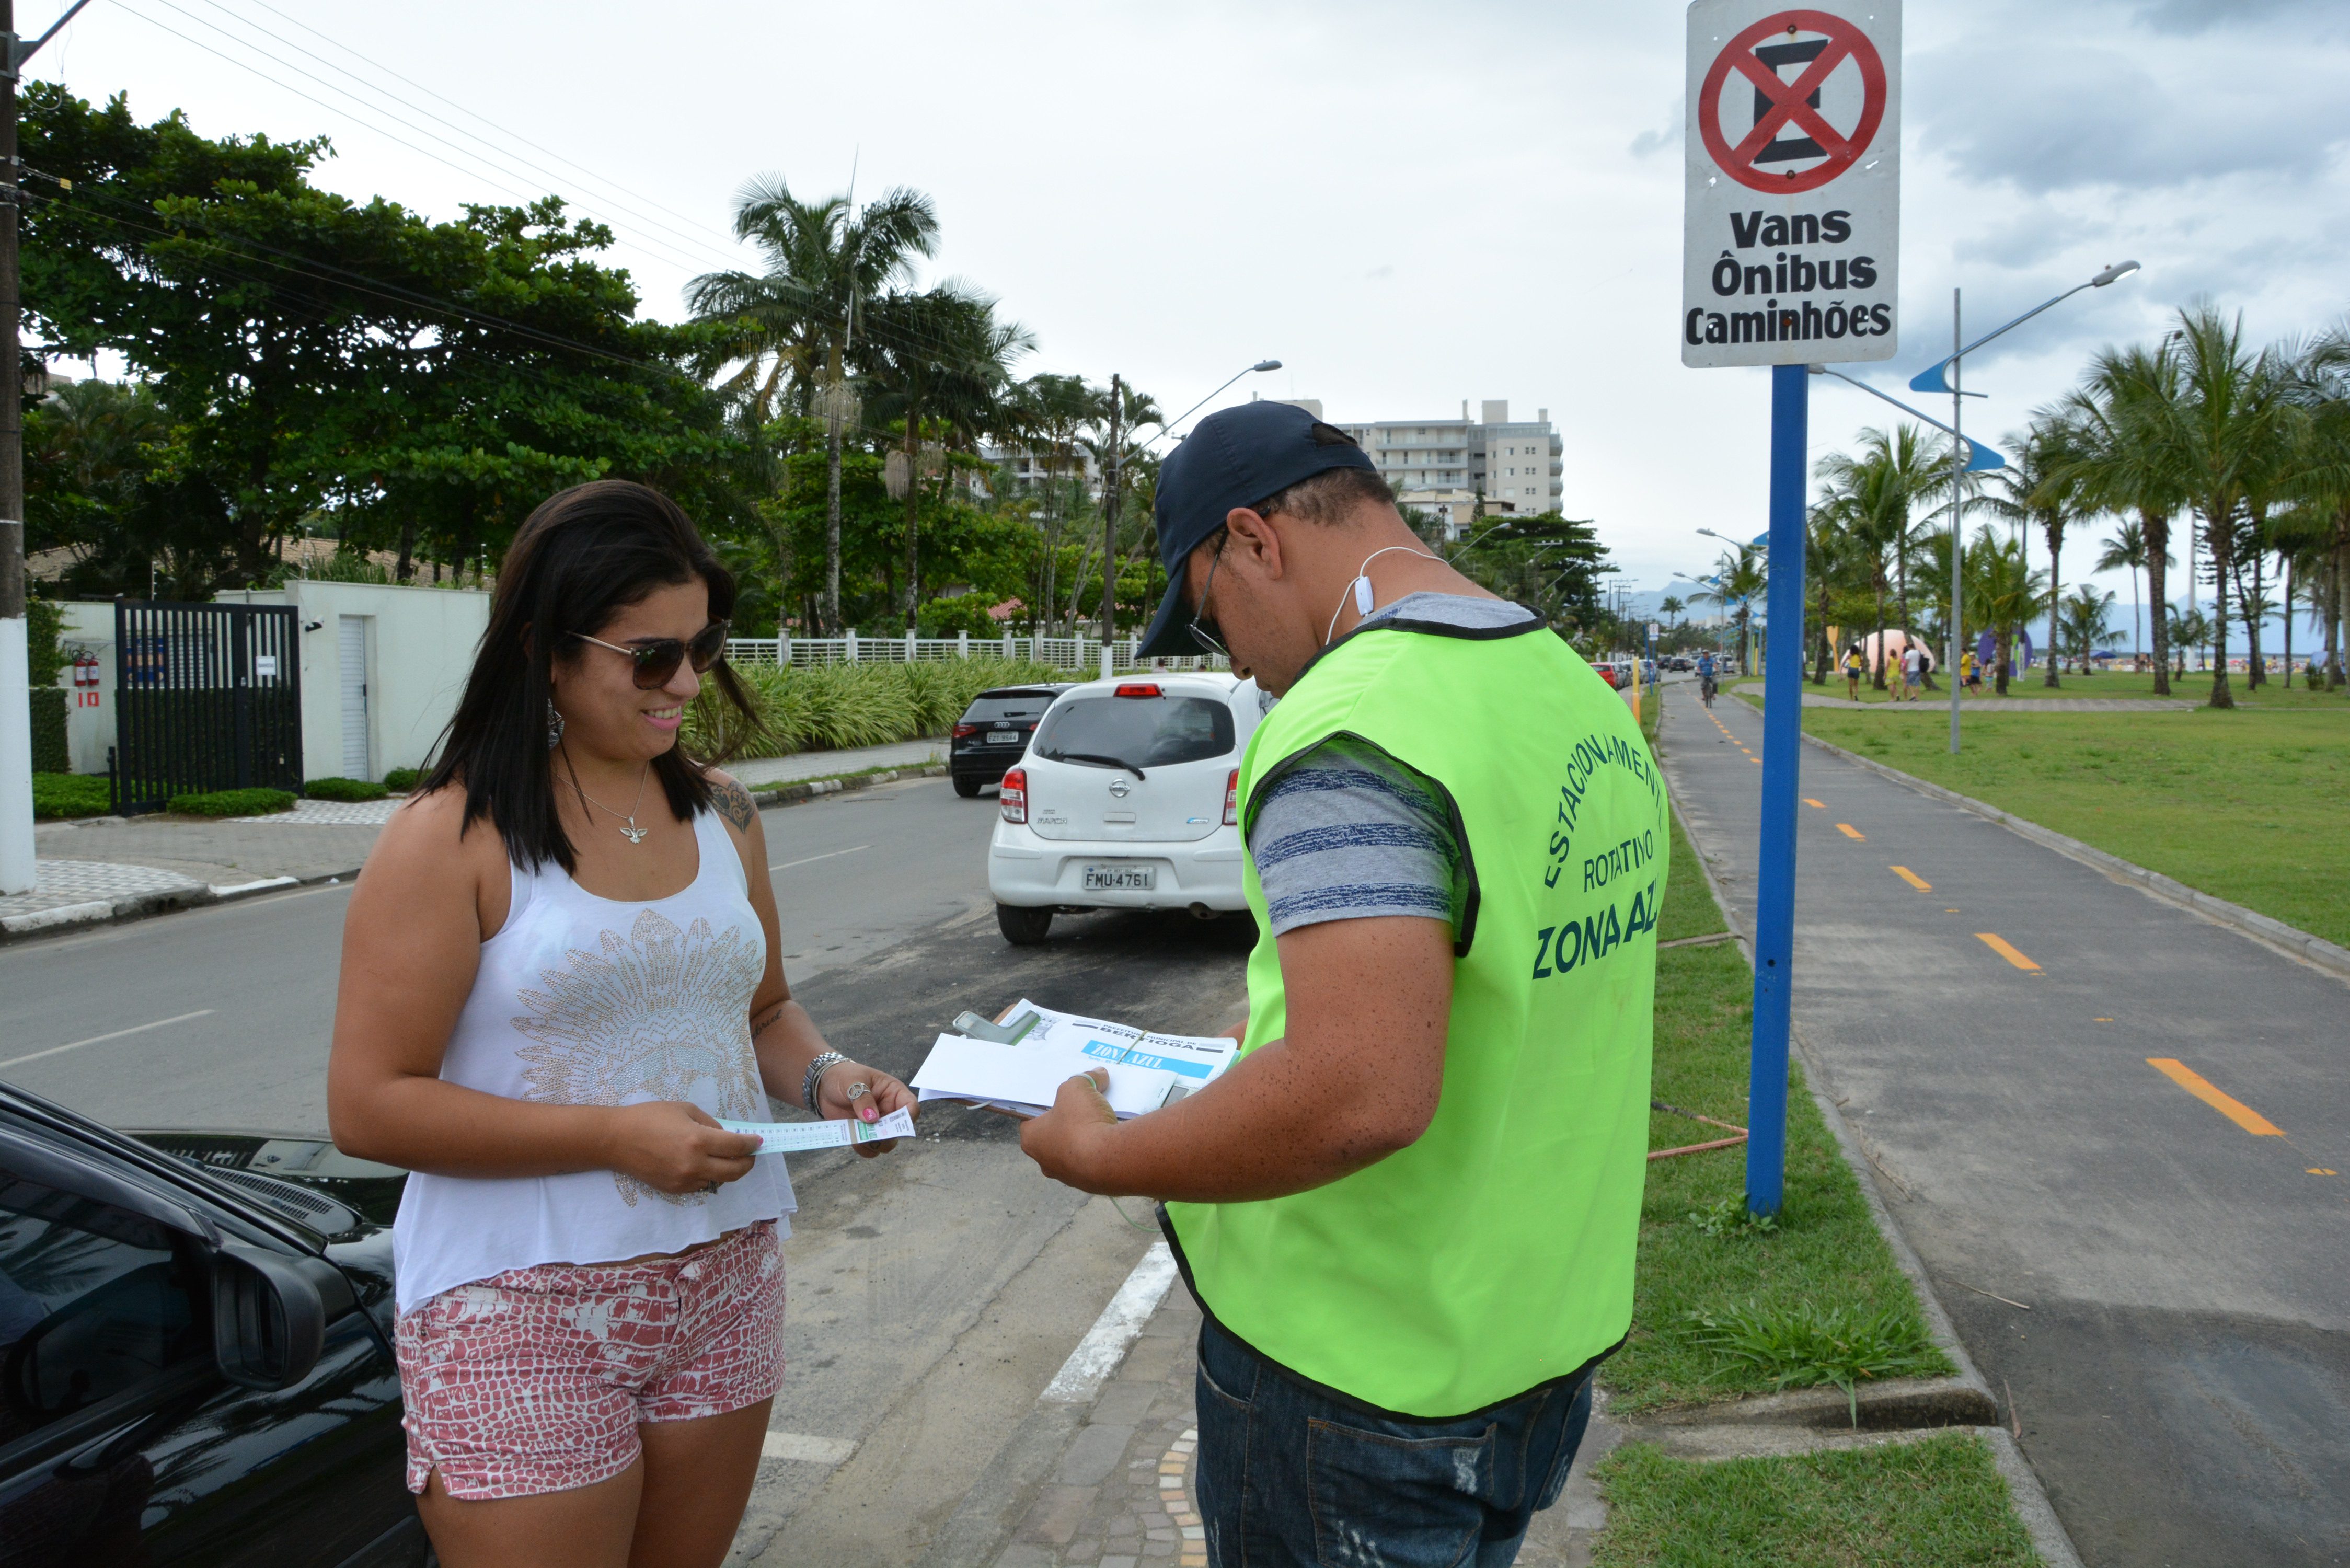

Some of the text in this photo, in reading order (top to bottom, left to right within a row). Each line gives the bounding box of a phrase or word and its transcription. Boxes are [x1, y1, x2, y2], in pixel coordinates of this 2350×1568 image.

[1730, 210, 1851, 249] Vans
[1711, 250, 1877, 296] Ônibus
[1686, 299, 1891, 345] Caminhões
[1544, 732, 1661, 890] ESTACIONAMENT
[1583, 828, 1653, 893] ROTATIVO
[1532, 903, 1621, 980] ZONA
[1100, 1027, 1194, 1050] BERTIOGA
[1103, 1024, 1144, 1037] PREFEITUR
[1147, 1035, 1184, 1044] MUNICIPAL
[1127, 1053, 1162, 1069] AZUL
